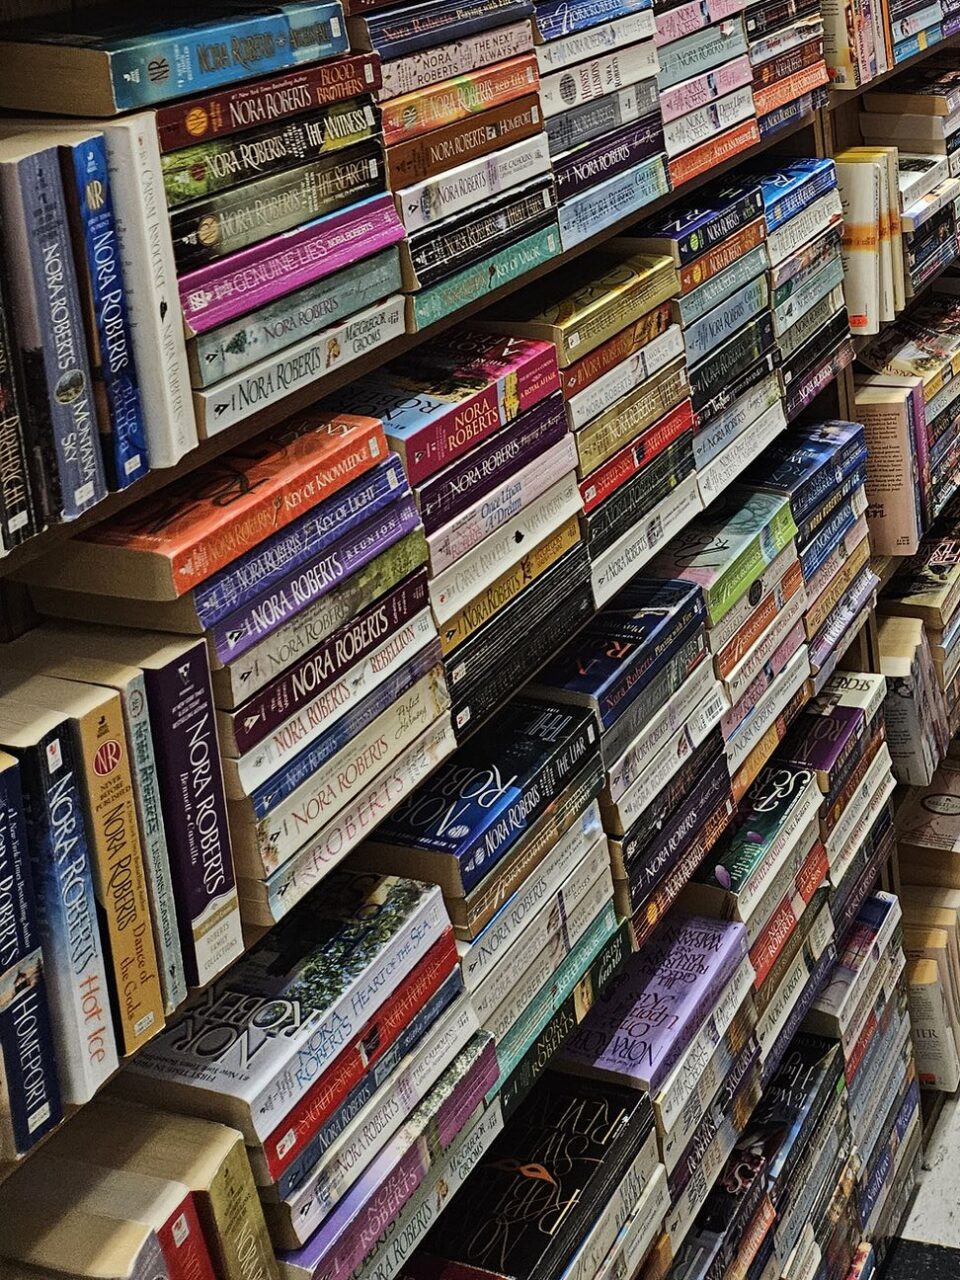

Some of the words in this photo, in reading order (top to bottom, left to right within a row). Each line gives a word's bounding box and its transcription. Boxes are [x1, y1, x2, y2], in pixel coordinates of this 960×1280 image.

[423, 52, 451, 70] NORA
[474, 41, 490, 54] THE
[491, 30, 514, 47] NEXT
[479, 44, 514, 64] ALWAYS
[417, 63, 460, 86] ROBERTS
[229, 91, 264, 128] NORA
[265, 83, 313, 117] ROBERTS
[304, 122, 324, 146] THE
[323, 108, 368, 139] WITNESS
[205, 150, 241, 180] NORA
[240, 136, 287, 171] ROBERTS
[430, 143, 454, 164] NORA
[453, 129, 486, 155] ROBERTS
[42, 246, 60, 298] NORA
[92, 230, 119, 292] NORA
[232, 254, 299, 293] GENUINE
[299, 239, 328, 265] LIES
[49, 297, 76, 371] ROBERTS
[99, 289, 129, 374] ROBERTS
[263, 317, 297, 340] NORA
[298, 294, 339, 325] ROBERTS
[238, 374, 277, 412] NORA
[276, 345, 323, 390] ROBERTS
[73, 399, 97, 482] MONTANA
[447, 406, 498, 452] ROBERTS
[453, 397, 489, 429] NORA
[61, 432, 78, 463] SKY
[449, 463, 481, 496] NORA
[480, 436, 520, 475] ROBERTS
[345, 519, 398, 561] REUNION
[251, 590, 291, 633] NORA
[291, 553, 345, 601] ROBERTS
[291, 652, 334, 702] NORA
[335, 607, 390, 664] ROBERTS
[369, 623, 417, 675] REBELLION
[272, 716, 308, 756] NORA
[305, 679, 351, 729] ROBERTS
[186, 712, 213, 795] NORA
[291, 783, 338, 827] NORA
[336, 734, 391, 793] ROBERTS
[555, 756, 572, 780] THE
[568, 736, 587, 765] LIAR
[47, 770, 78, 863] NORA
[102, 804, 125, 863] NORA
[194, 790, 227, 896] ROBERTS
[483, 822, 511, 859] NORA
[508, 787, 542, 835] ROBERTS
[60, 856, 99, 976] ROBERTS
[106, 858, 137, 929] ROBERTS
[483, 918, 511, 963] NORA
[511, 878, 550, 925] ROBERTS
[132, 921, 148, 967] Dance
[140, 968, 153, 986] of
[80, 974, 102, 1022] Hot
[10, 991, 47, 1110] HOMEPORT
[88, 1025, 106, 1065] Ice
[295, 1015, 354, 1090] ROBERTS
[296, 1012, 342, 1061] NORA
